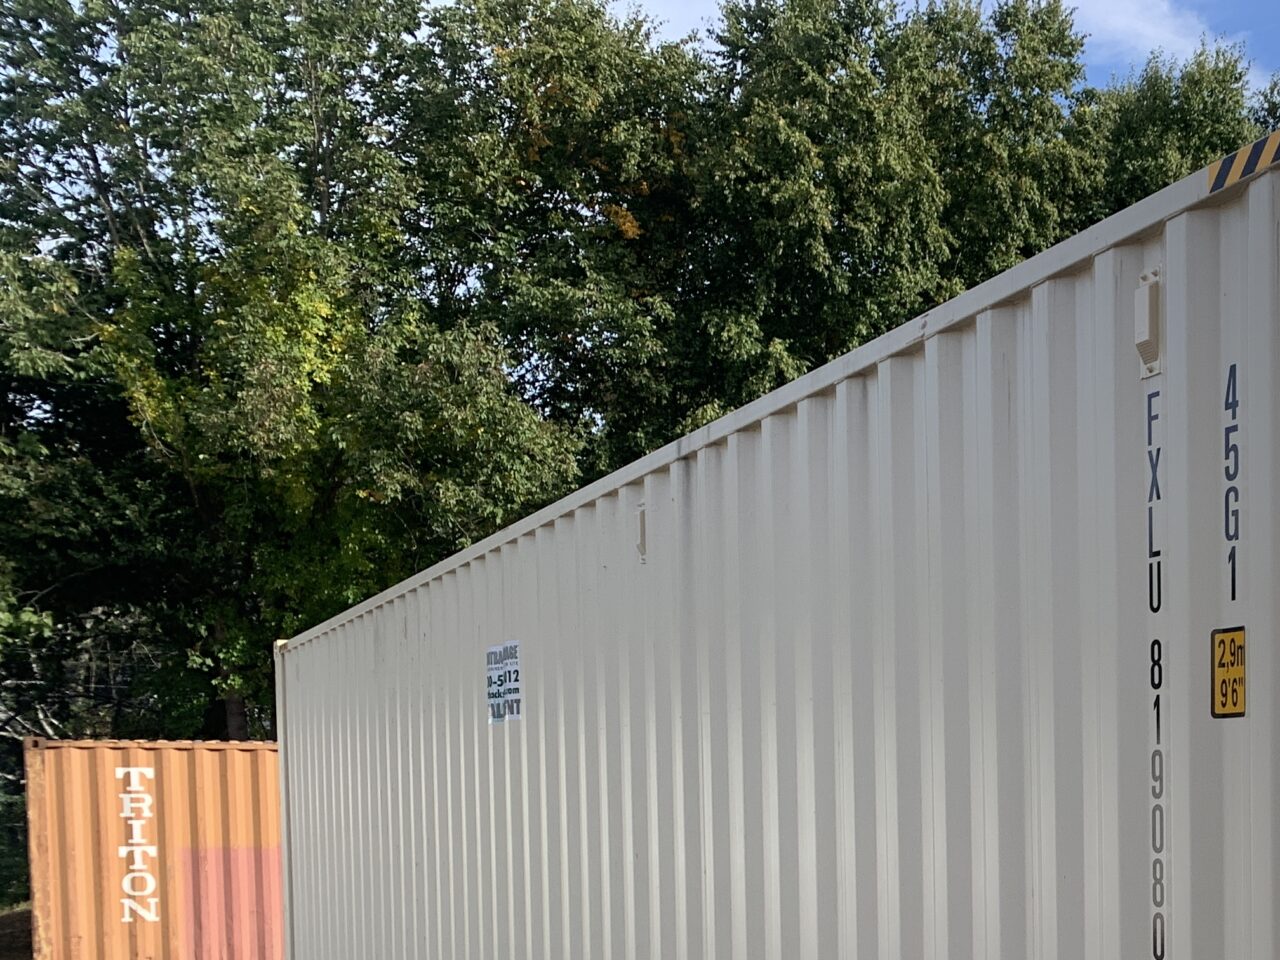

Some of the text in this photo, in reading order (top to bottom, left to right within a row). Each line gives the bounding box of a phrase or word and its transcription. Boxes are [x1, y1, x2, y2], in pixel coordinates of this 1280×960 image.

[1147, 390, 1162, 613] FXLU
[1224, 363, 1240, 601] 45G1
[115, 767, 160, 922] TRITON
